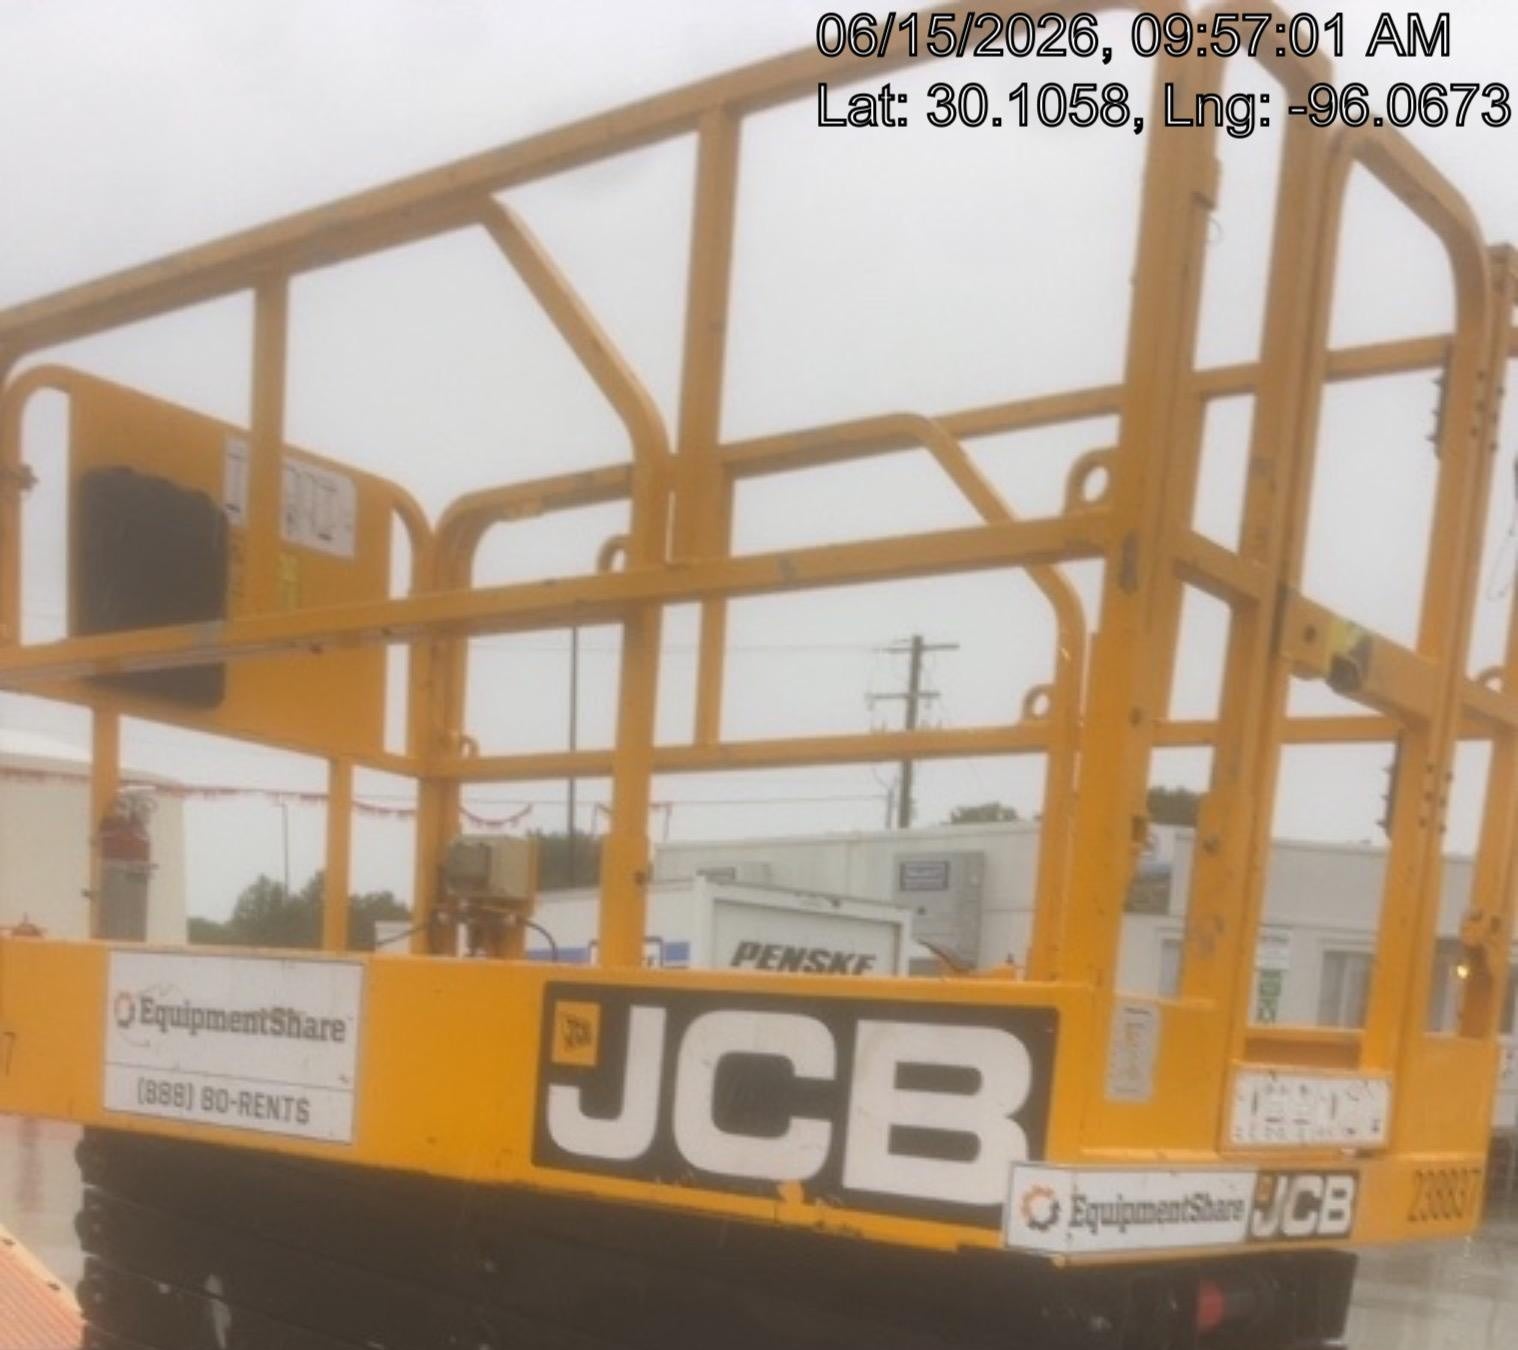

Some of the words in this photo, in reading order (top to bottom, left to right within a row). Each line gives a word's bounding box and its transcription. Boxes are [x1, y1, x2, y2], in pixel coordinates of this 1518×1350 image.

[139, 997, 346, 1042] EquipmentShare
[137, 1077, 194, 1111] (888)
[547, 1004, 1032, 1205] JCB
[1069, 1192, 1244, 1233] EquipmentShare
[1251, 1175, 1354, 1237] JCB
